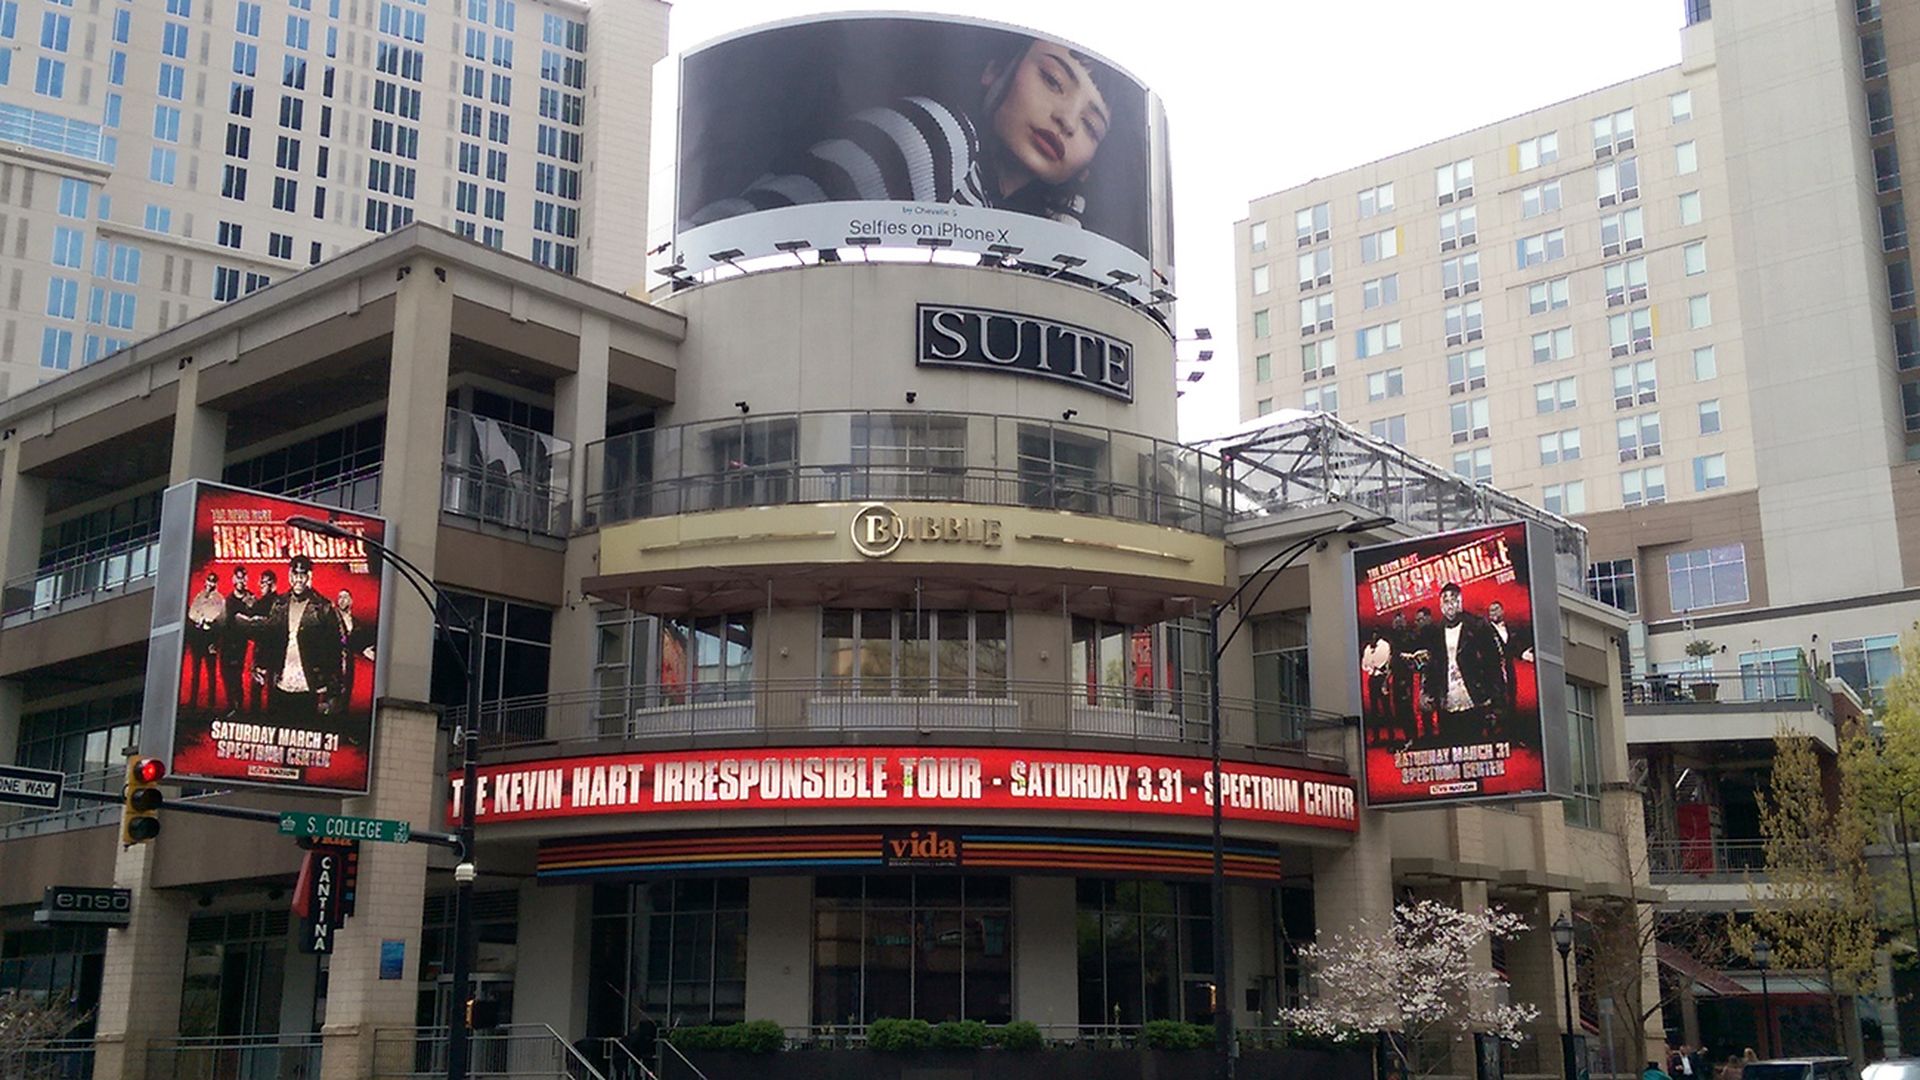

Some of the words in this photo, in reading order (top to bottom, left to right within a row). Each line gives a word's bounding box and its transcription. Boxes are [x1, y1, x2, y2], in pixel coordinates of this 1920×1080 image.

[850, 219, 907, 235] Selfies
[911, 223, 933, 235] on
[937, 222, 995, 242] iPhone
[998, 229, 1009, 244] X
[931, 310, 1129, 390] SUITE
[865, 515, 1003, 548] BUBBLE
[211, 720, 276, 744] SATURDAY
[278, 728, 322, 749] MARCH
[324, 733, 339, 752] 31
[217, 740, 284, 764] SPECTRUM
[1394, 747, 1450, 769] SATURDAY
[1452, 744, 1494, 763] MARCH
[1496, 742, 1510, 759] 31
[1462, 760, 1505, 779] CENTER
[0, 778, 21, 793] NE
[25, 781, 52, 796] WAY
[452, 776, 488, 818] TE
[494, 769, 563, 814] KEVIN
[572, 764, 644, 807] HART
[653, 757, 887, 803] IRRESPONSIBLE
[899, 756, 982, 799] TOUR
[1010, 760, 1130, 800] SATURDAY
[1137, 766, 1183, 803] 3.31
[1203, 771, 1300, 813] SPECTRUM
[1303, 781, 1355, 821] CENTER
[325, 818, 383, 839] COLLEGE
[889, 831, 957, 858] vida
[314, 856, 332, 951] CANTINA
